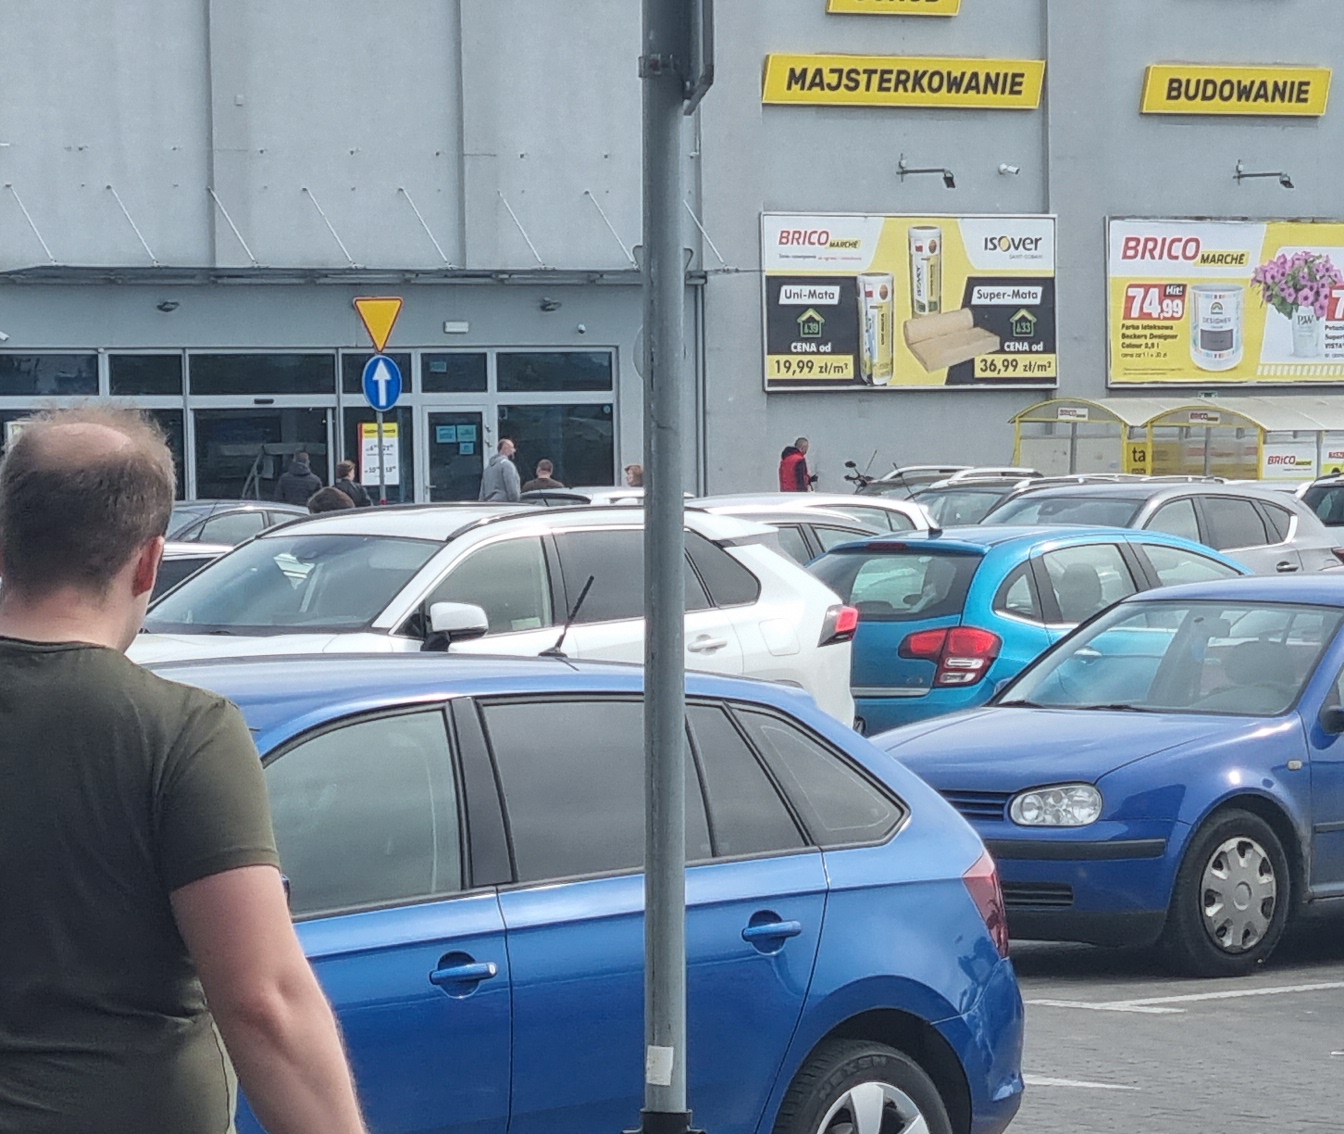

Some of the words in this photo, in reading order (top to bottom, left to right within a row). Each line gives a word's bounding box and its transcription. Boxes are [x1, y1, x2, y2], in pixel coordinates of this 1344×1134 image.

[786, 67, 1025, 96] MAJSTERKOWANIE
[1166, 78, 1310, 104] BUDOWANIE
[778, 230, 830, 246] BRICO
[1121, 237, 1201, 261] BRICO
[784, 289, 835, 300] Uni-Mata
[976, 288, 1038, 302] Super-Mata
[1166, 285, 1183, 296] Hit!
[1127, 287, 1183, 320] 74,99
[791, 342, 817, 353] CENA
[819, 342, 832, 353] od
[1004, 342, 1029, 352] CENA
[1031, 341, 1044, 352] od
[775, 359, 815, 376] 19,99
[979, 358, 1019, 375] 36,99
[1132, 447, 1146, 463] ta
[1267, 455, 1296, 466] BRICO
